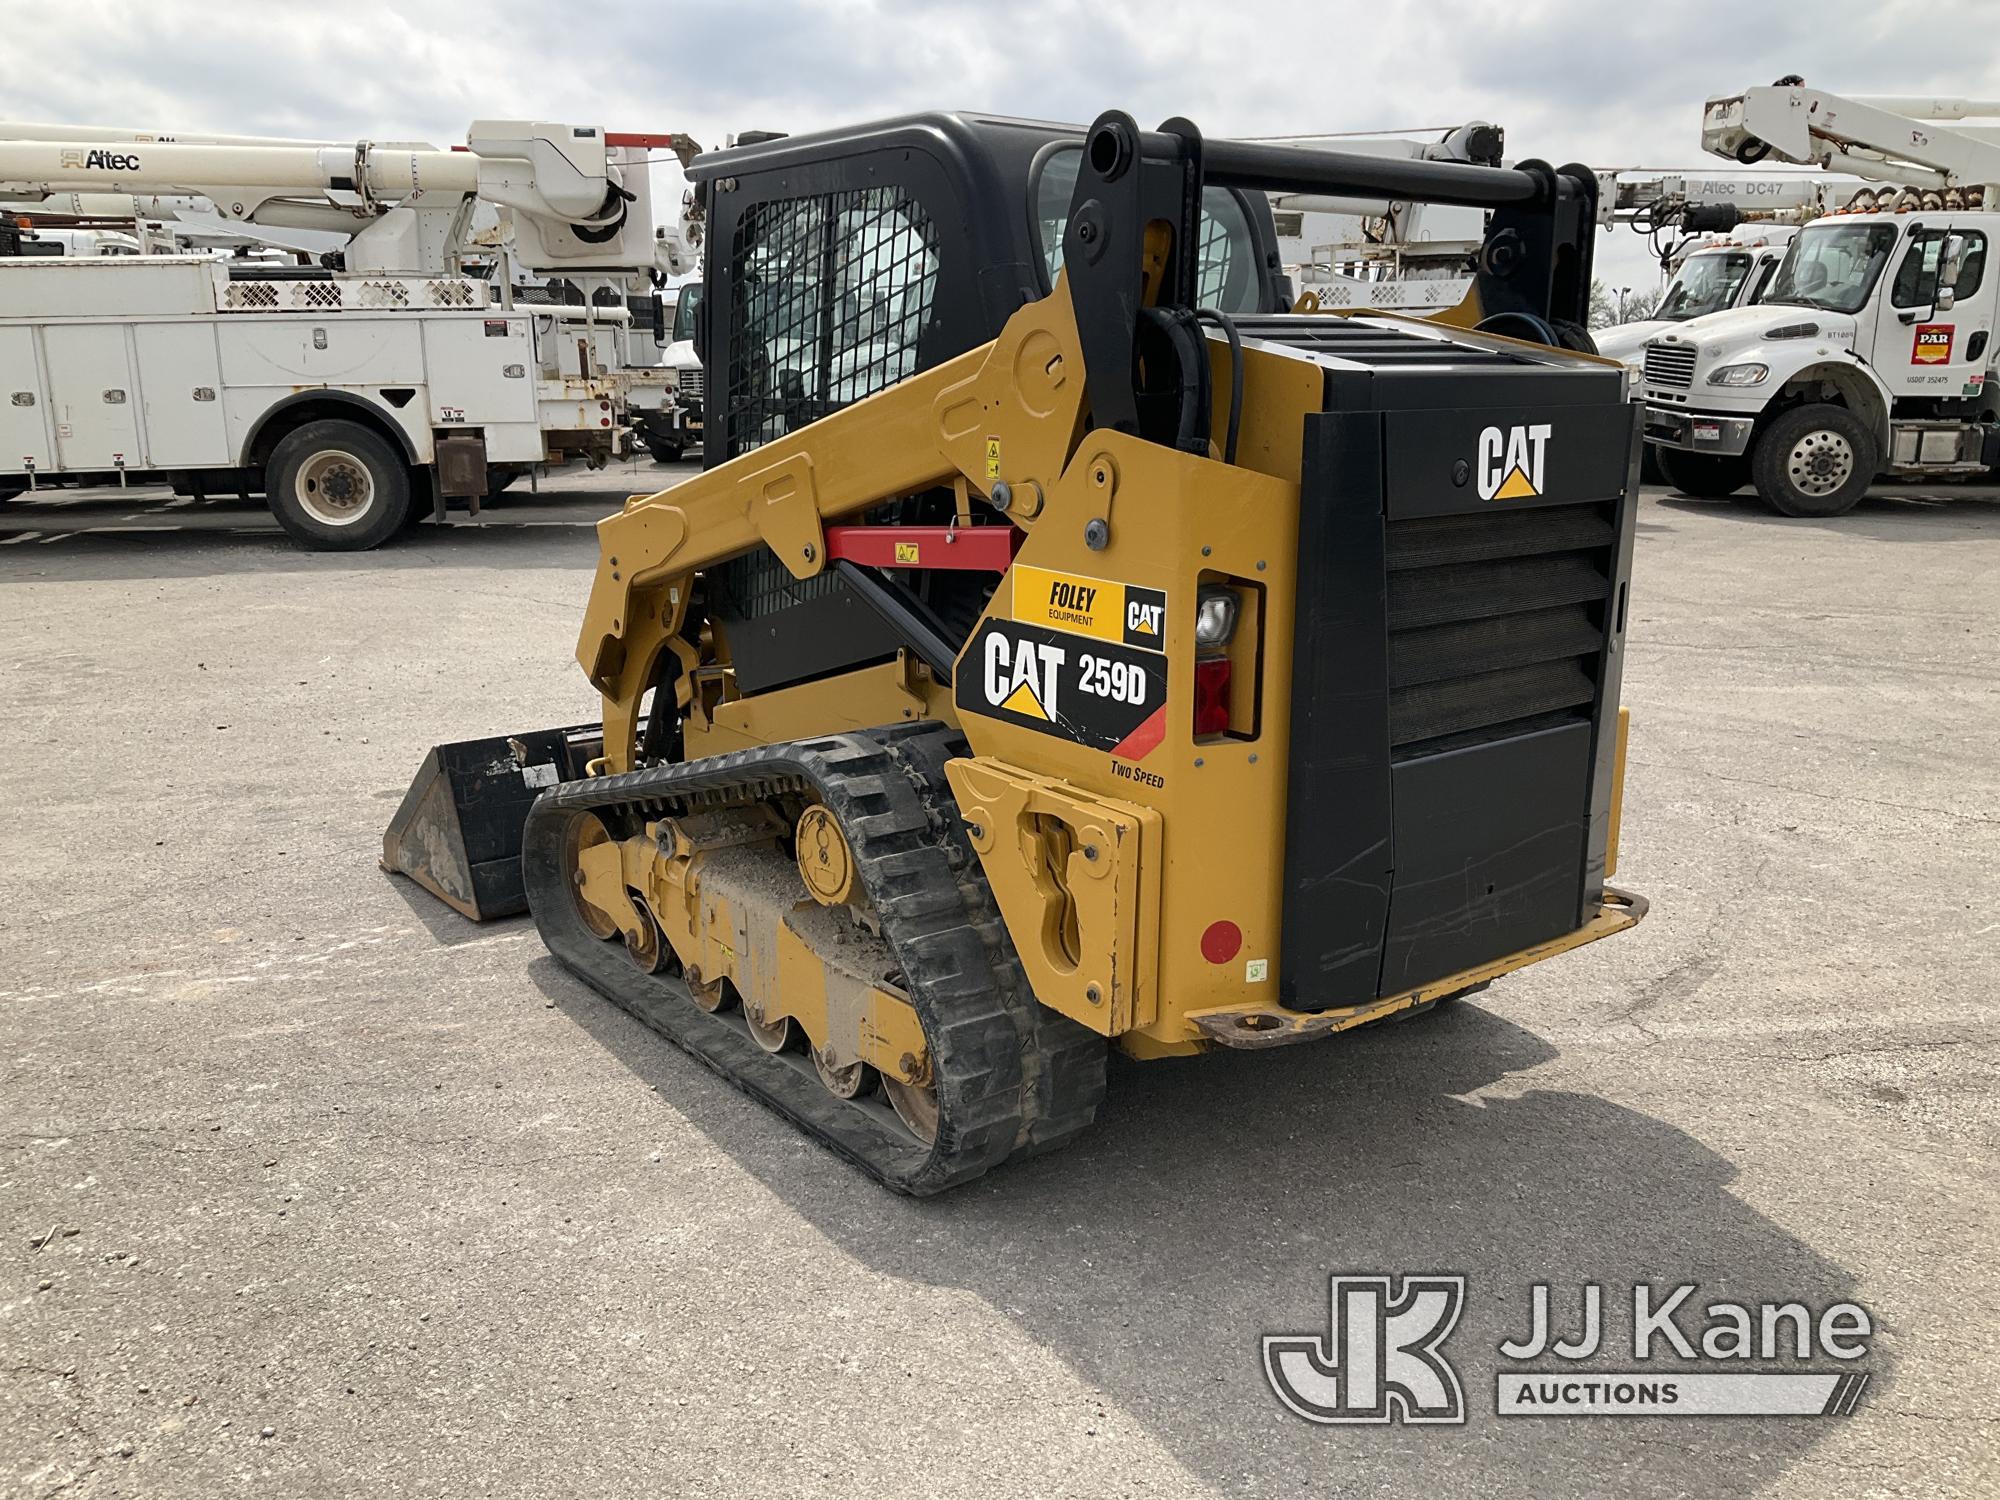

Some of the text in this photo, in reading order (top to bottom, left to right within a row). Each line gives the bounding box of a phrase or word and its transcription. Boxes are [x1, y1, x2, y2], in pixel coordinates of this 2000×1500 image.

[85, 149, 140, 171] Altec
[1702, 181, 1783, 195] Altec DC47
[1920, 334, 1949, 344] PAR
[1907, 376, 1926, 384] USDOT
[1478, 424, 1551, 500] CAT
[1050, 581, 1096, 613] FOLEY
[1048, 608, 1094, 627] EQUIPMENT
[1128, 601, 1163, 636] CAT
[984, 632, 1147, 723] CAT 259D
